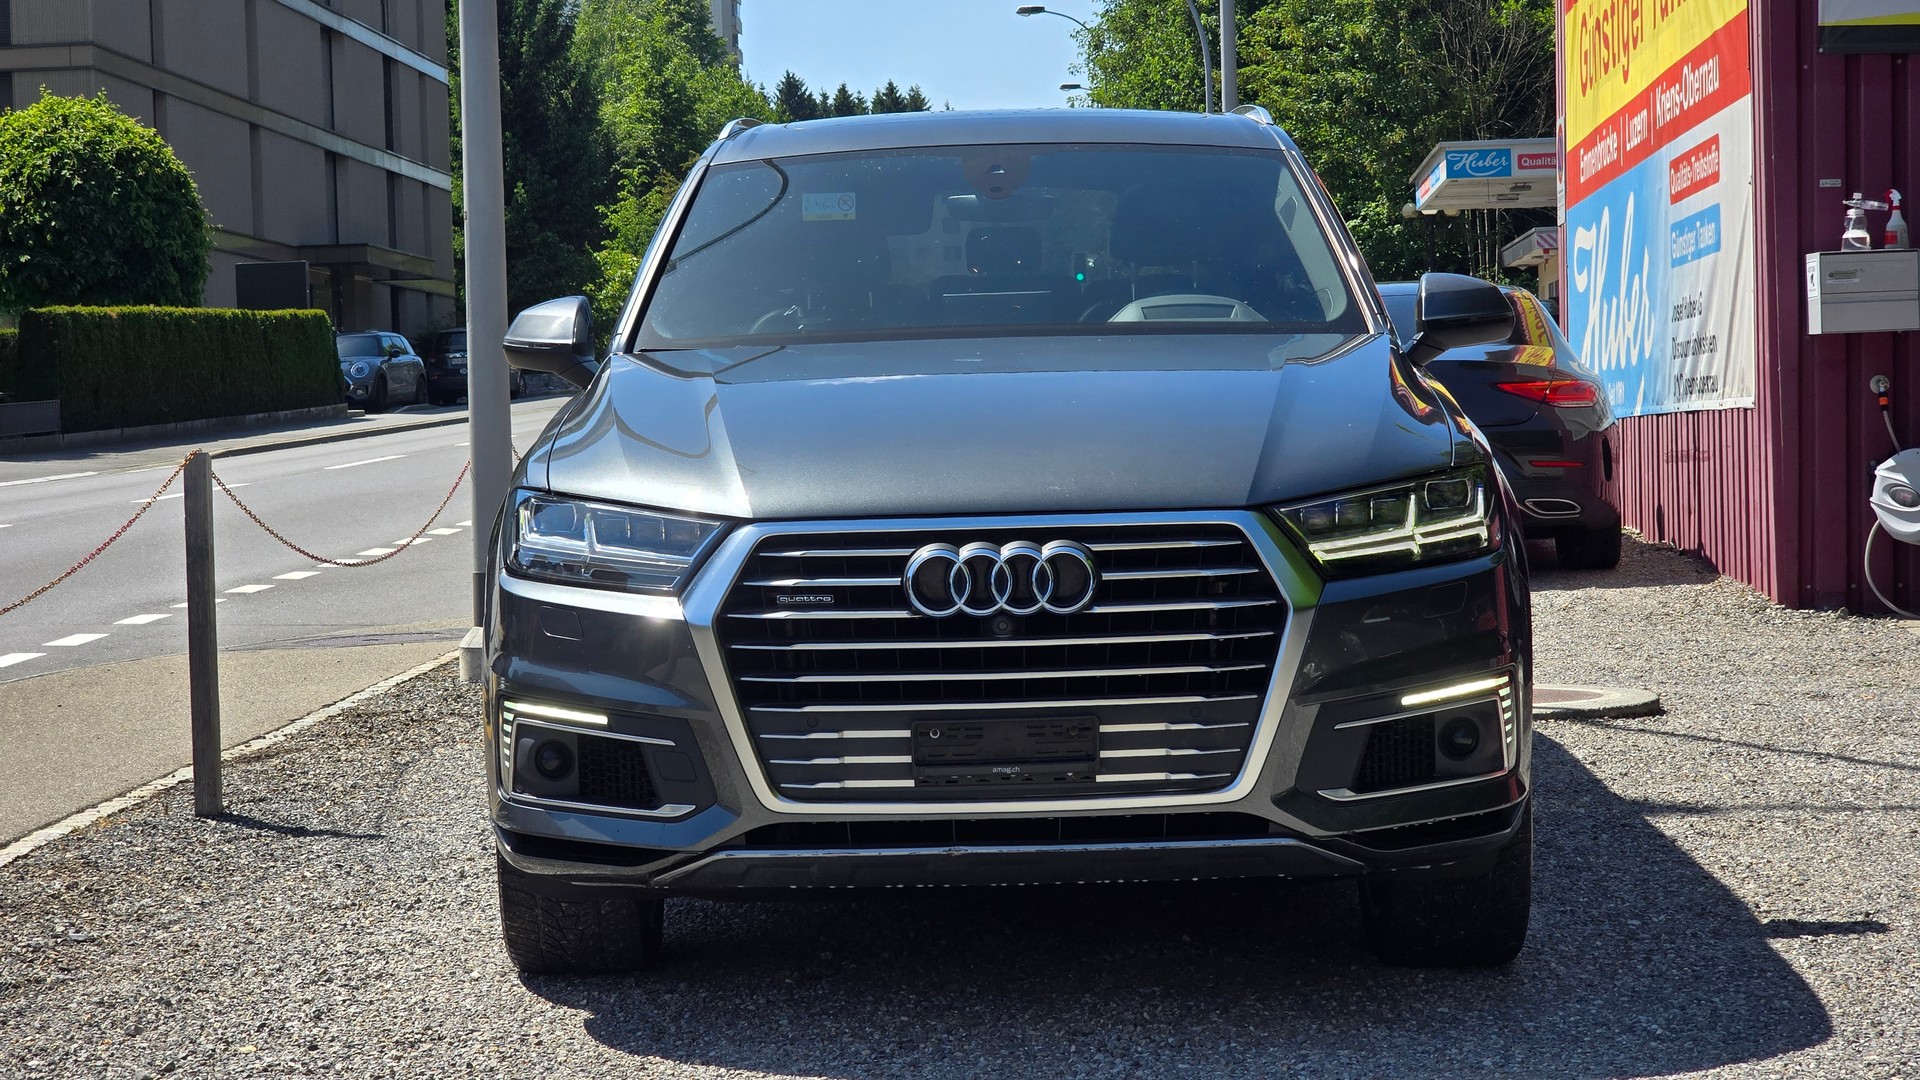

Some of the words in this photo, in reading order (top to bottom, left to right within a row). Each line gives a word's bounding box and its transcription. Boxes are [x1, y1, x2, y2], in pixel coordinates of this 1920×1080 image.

[1580, 0, 1643, 97] Günstiger
[1579, 125, 1618, 184] Emmenbrücke
[1626, 108, 1648, 151] Luzern
[1656, 54, 1720, 130] Kriens-Obernau
[1447, 151, 1509, 176] Huber
[1521, 156, 1556, 167] Qualitä
[1670, 144, 1719, 195] Qualitäts-Treibstoffe
[1671, 226, 1696, 260] Günstiger
[1696, 218, 1716, 250] Tanken
[1573, 191, 1655, 412] Huber
[992, 766, 1020, 774] amag.ch
